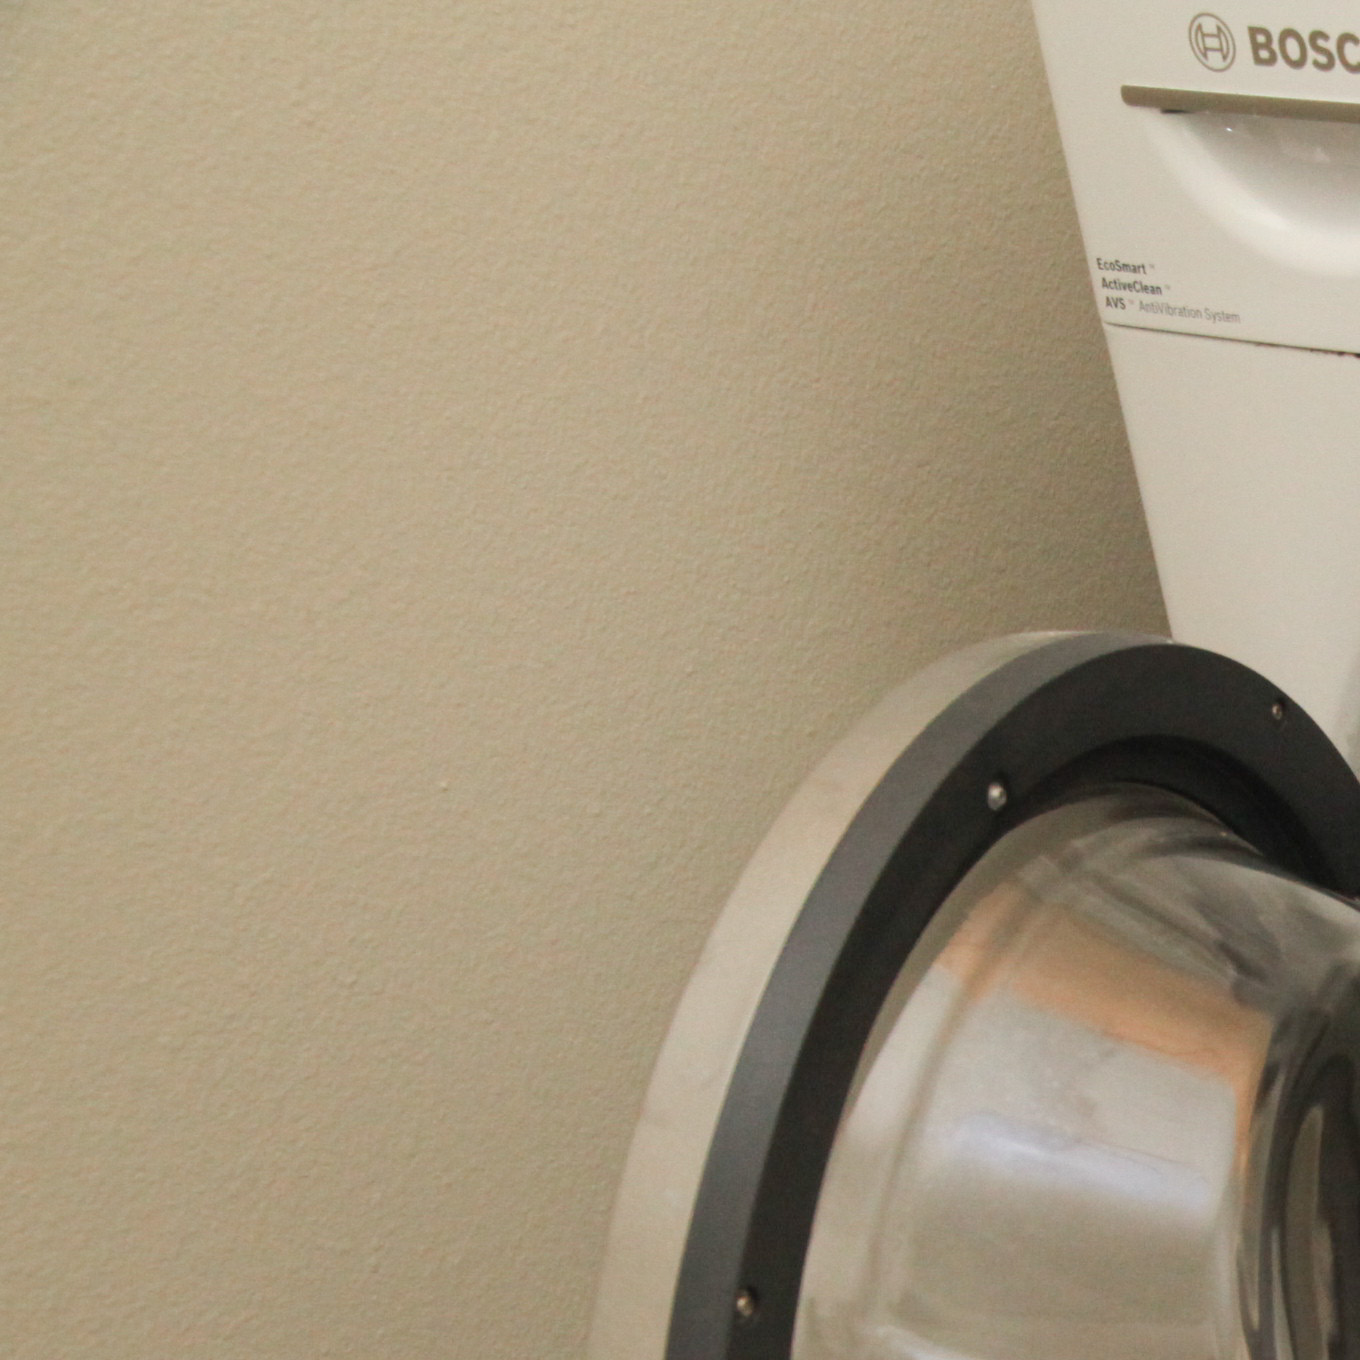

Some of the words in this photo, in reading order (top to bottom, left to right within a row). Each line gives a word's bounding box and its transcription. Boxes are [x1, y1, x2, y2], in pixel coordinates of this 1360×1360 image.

[1096, 258, 1147, 274] EcoSmart
[1101, 277, 1162, 295] ActiveClean
[1105, 296, 1126, 310] AVS
[1139, 300, 1202, 319] AntiVibration
[1205, 307, 1241, 324] System
